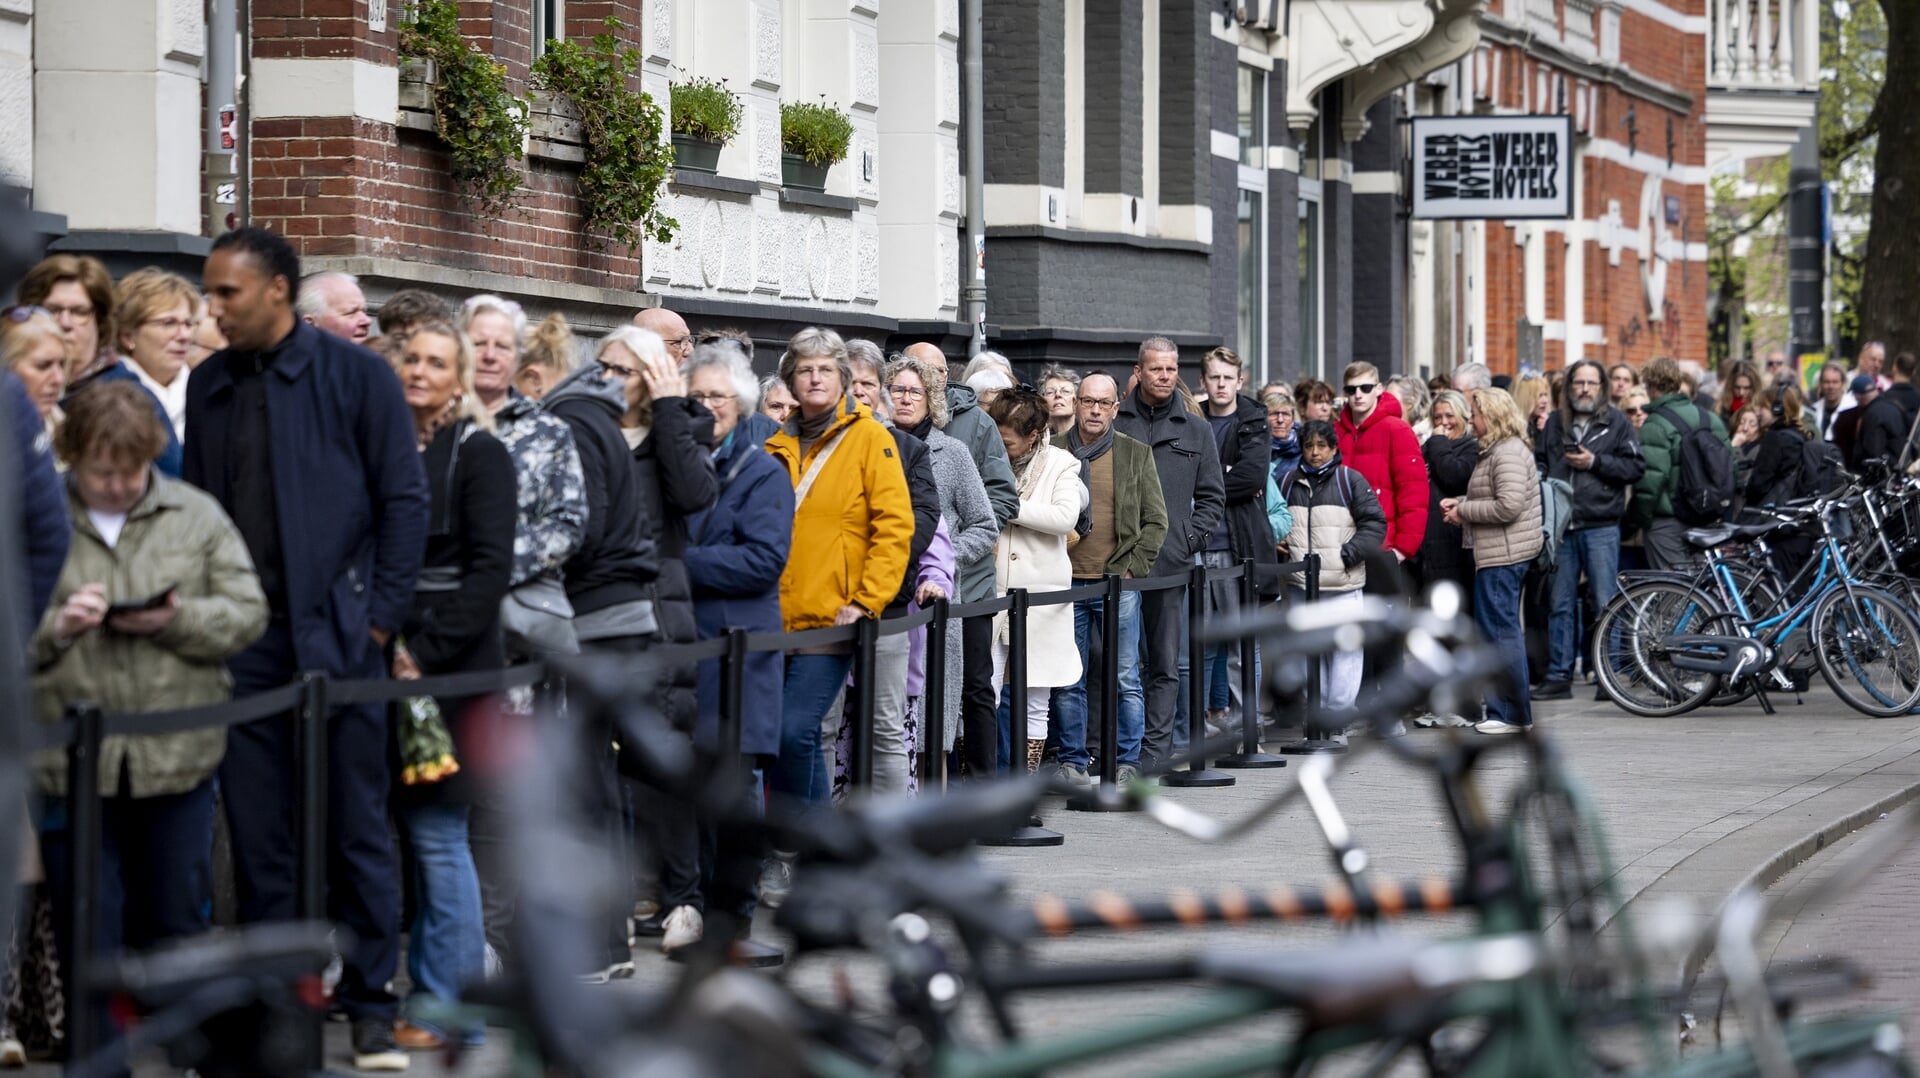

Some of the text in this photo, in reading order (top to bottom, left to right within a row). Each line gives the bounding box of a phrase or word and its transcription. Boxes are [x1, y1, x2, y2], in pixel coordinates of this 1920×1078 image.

[1424, 134, 1458, 200] WEBER
[1458, 133, 1490, 199] HOTELS
[1492, 132, 1558, 167] WEBER
[1493, 167, 1558, 199] HOTELS
